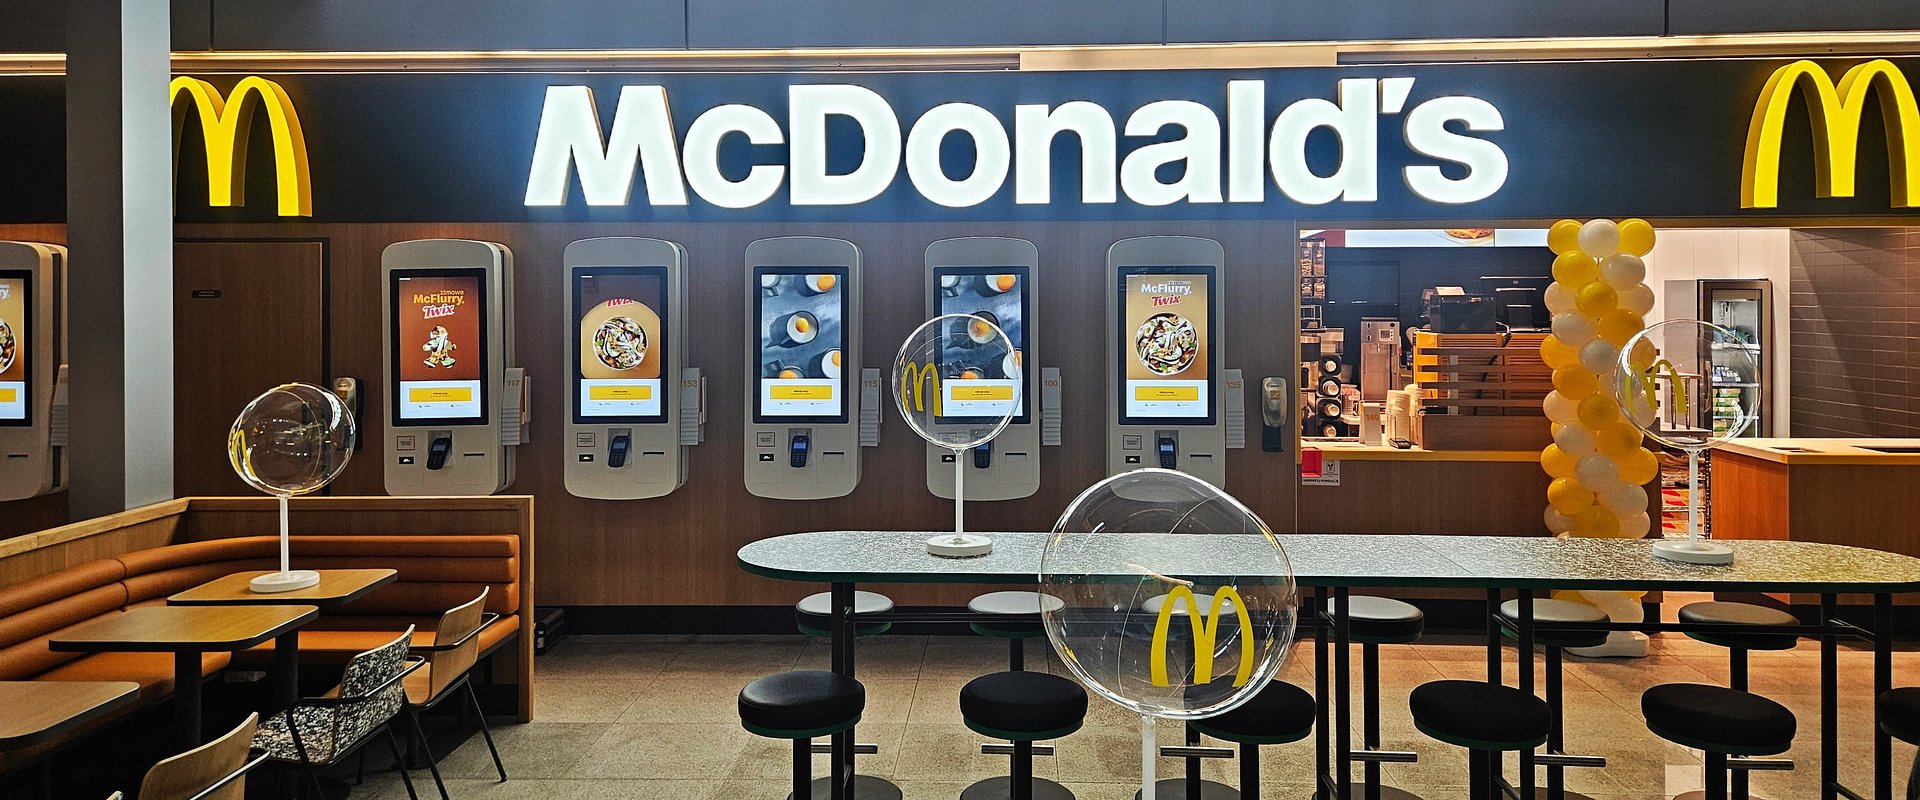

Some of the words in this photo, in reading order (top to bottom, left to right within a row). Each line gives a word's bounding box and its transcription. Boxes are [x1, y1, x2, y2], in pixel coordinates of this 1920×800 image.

[524, 78, 1509, 207] McDonald's
[1151, 293, 1182, 307] Twix
[422, 303, 455, 319] Twix
[683, 379, 698, 388] 153
[863, 380, 878, 388] 115
[1227, 381, 1242, 389] 135
